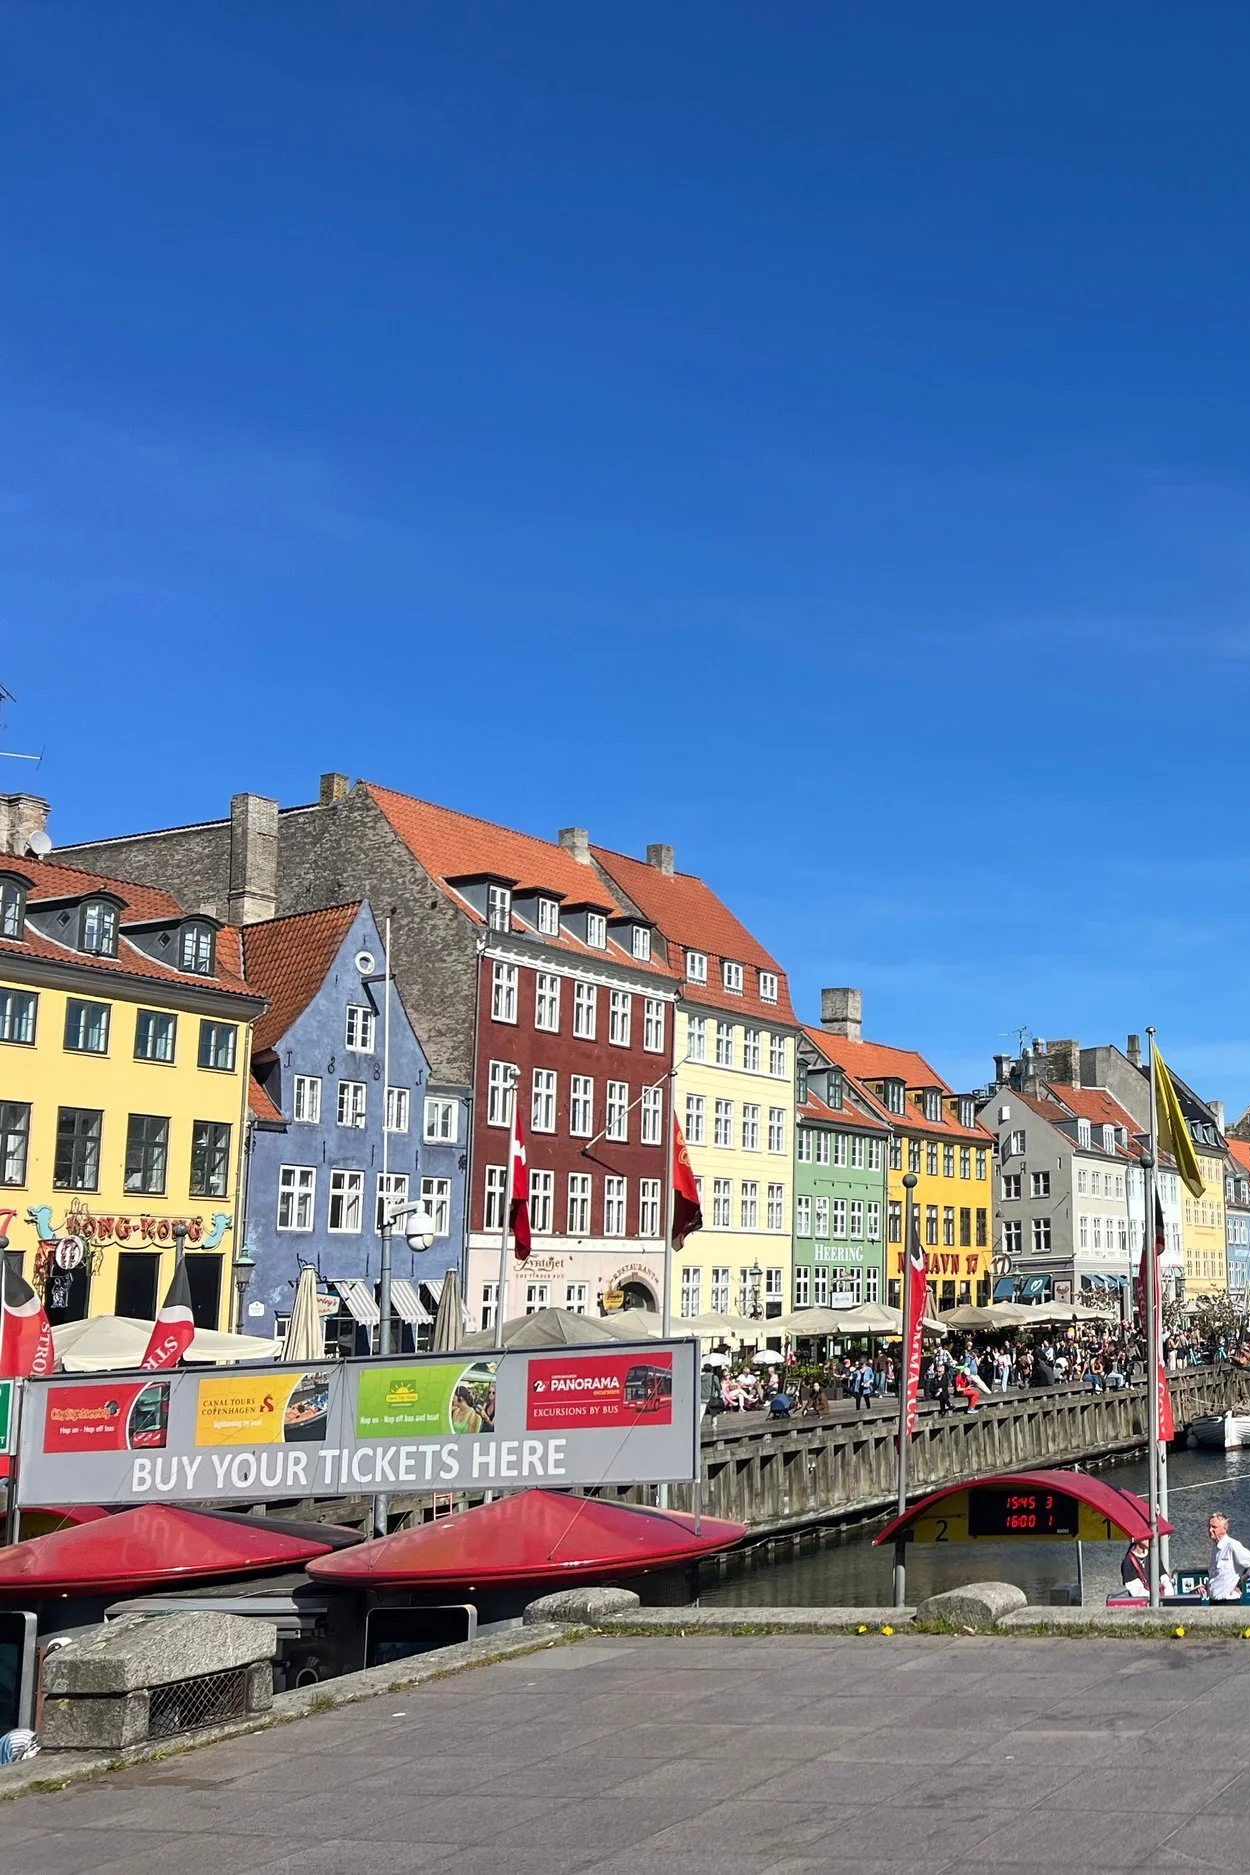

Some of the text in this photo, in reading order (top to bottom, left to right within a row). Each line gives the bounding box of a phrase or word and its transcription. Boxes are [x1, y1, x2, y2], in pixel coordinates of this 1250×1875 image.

[814, 1244, 864, 1262] HEERING
[897, 1252, 979, 1275] NHAVN 17
[613, 1263, 656, 1280] RESTAURANT
[551, 1377, 620, 1391] PANORAMA
[203, 1398, 256, 1408] CANAL TOURS
[201, 1407, 256, 1416] COPENHAGEN
[533, 1405, 619, 1417] EXCURSIONS BY BUS
[84, 1426, 94, 1434] Hop
[131, 1439, 567, 1492] BUY YOUR TICKETS HERE
[1006, 1496, 1053, 1509] 15:45 3
[1006, 1515, 1053, 1528] 16:00 1
[935, 1520, 949, 1542] 2
[1103, 1518, 1111, 1540] 1
